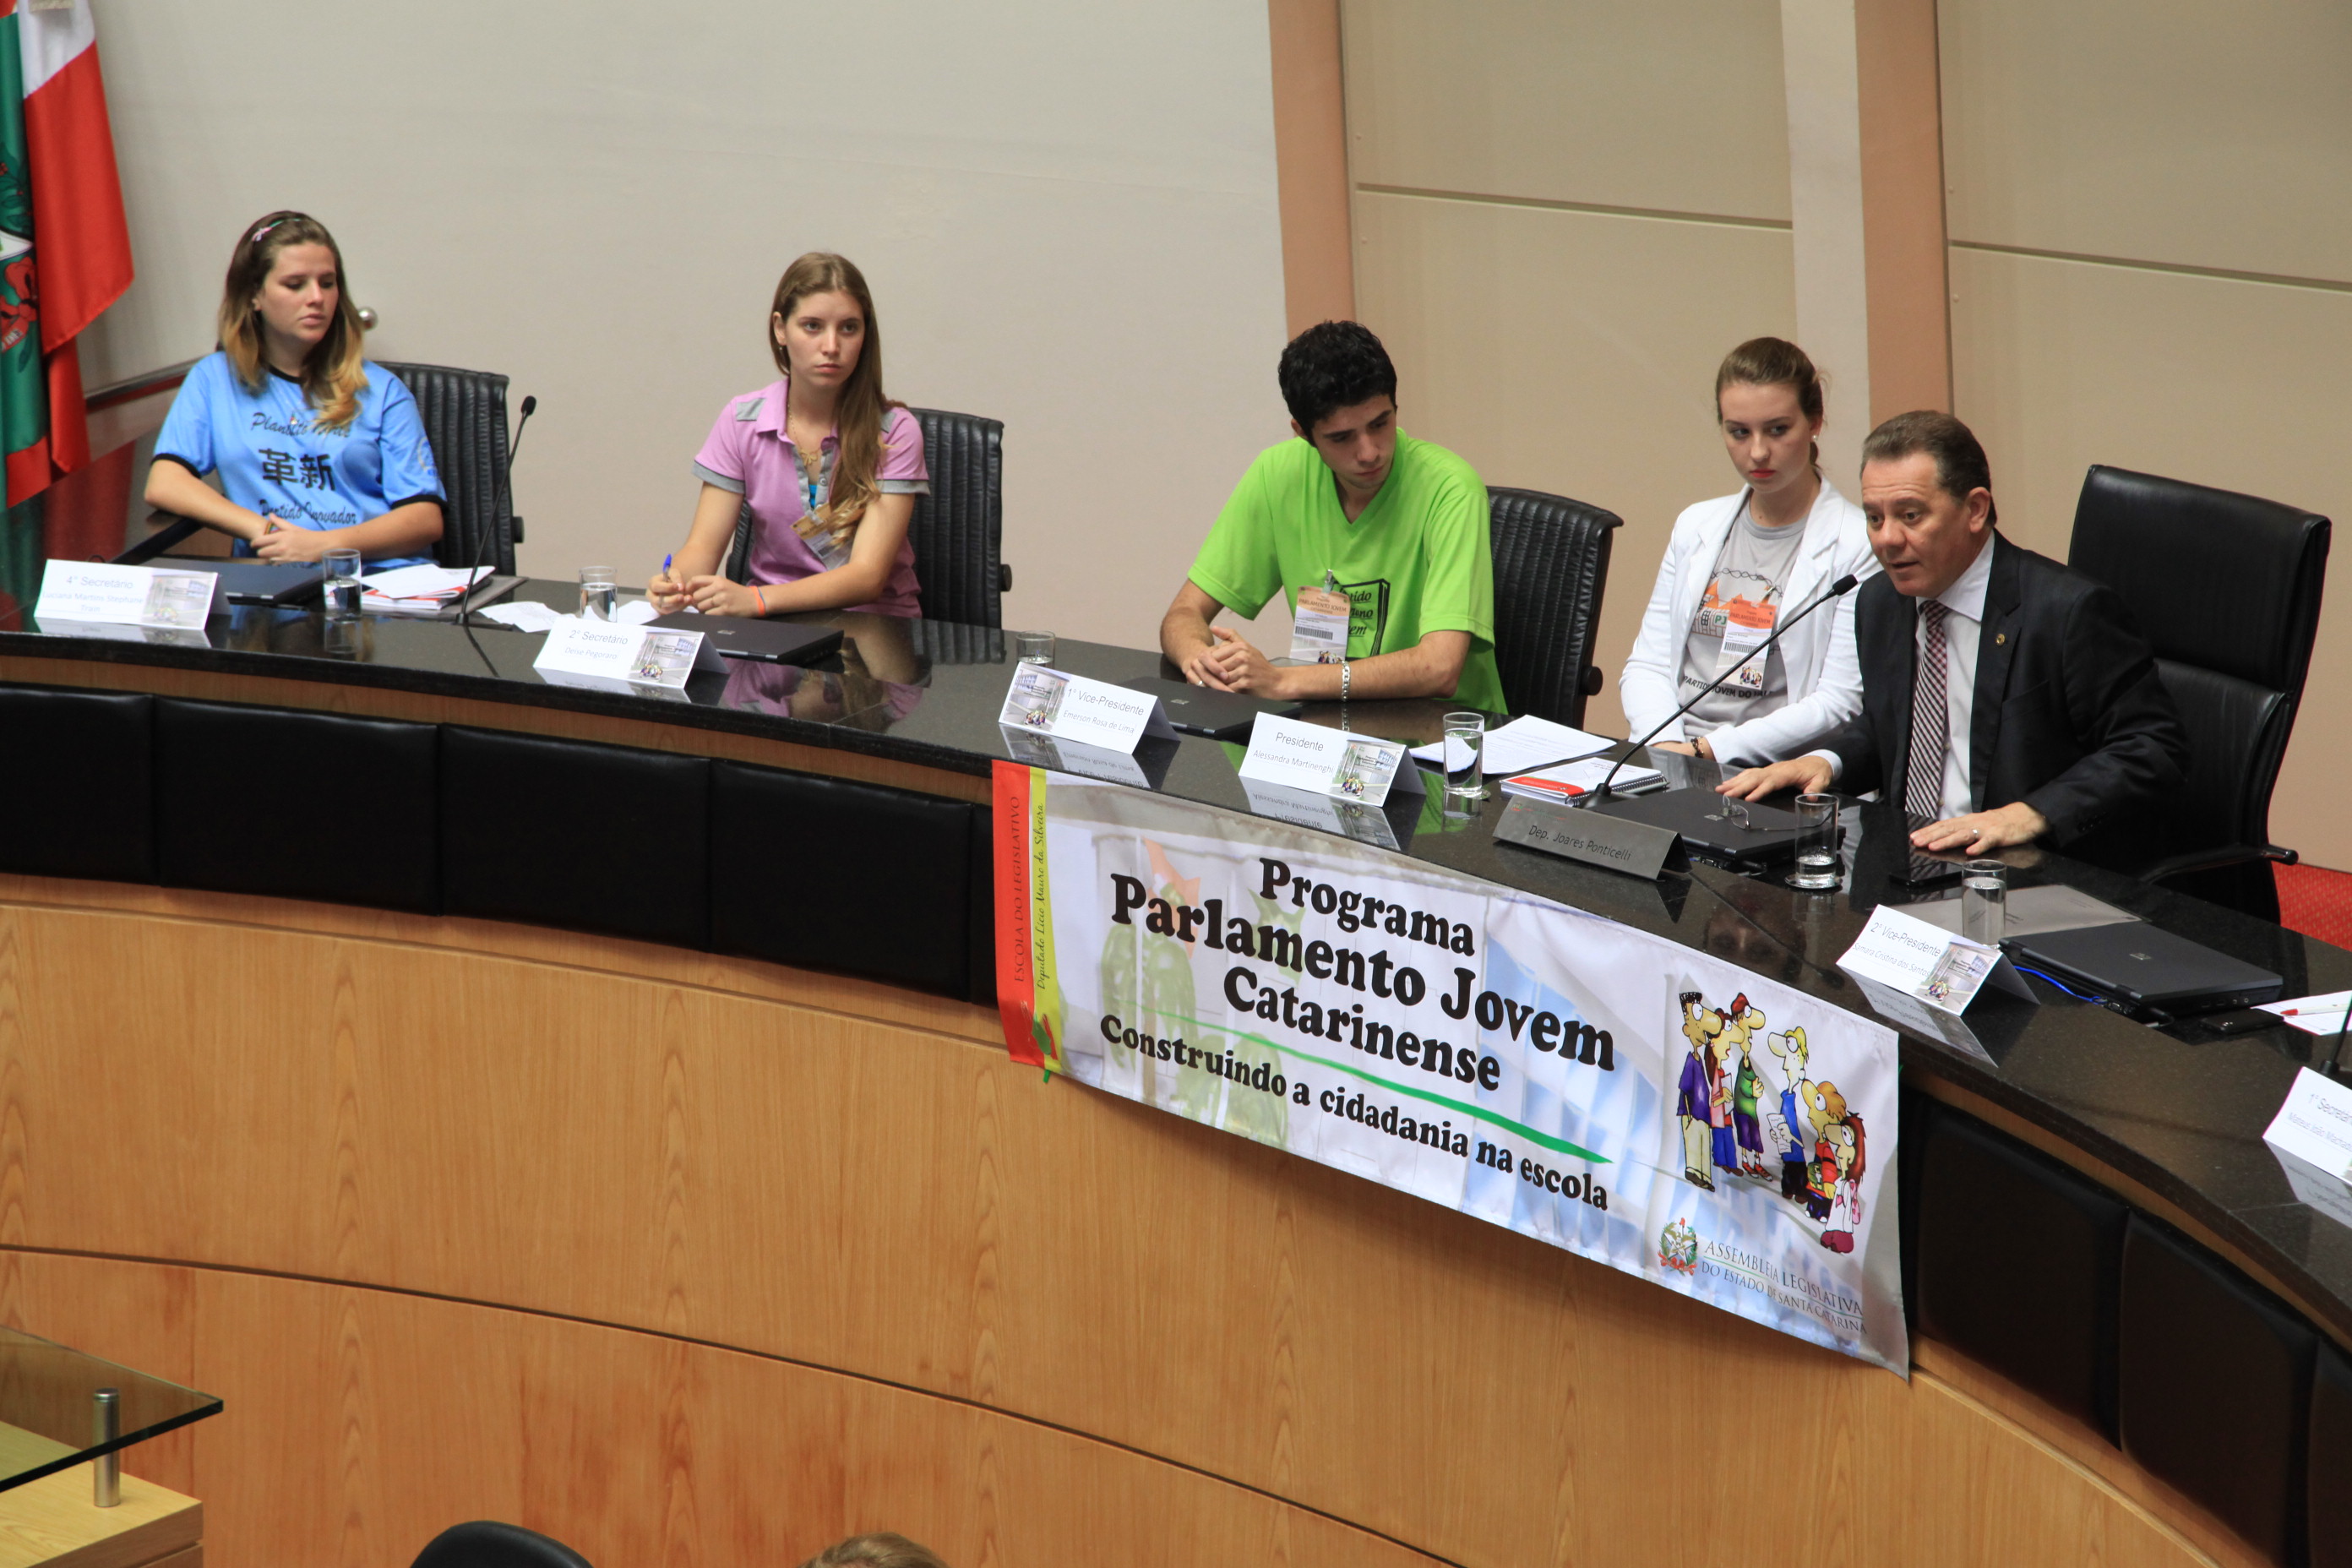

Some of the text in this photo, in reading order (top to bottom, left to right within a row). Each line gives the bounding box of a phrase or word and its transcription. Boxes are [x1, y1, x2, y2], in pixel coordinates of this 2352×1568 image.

[259, 448, 336, 492] 革新
[582, 631, 629, 645] Secretário
[1078, 690, 1145, 716] Vice-Presidente
[1685, 676, 1711, 690] PARTID
[1738, 689, 1752, 699] DO
[1064, 710, 1091, 723] Emerson
[1092, 716, 1108, 727] Rosa
[1108, 721, 1117, 729] de
[1276, 732, 1324, 752] Presidente
[1253, 749, 1334, 774] Alessandra Martinenghi
[1032, 803, 1044, 847] Silveira
[1529, 825, 1632, 861] Dep. Joares Ponticelli
[1033, 850, 1044, 864] da
[1010, 797, 1025, 983] ESCOLA DO LEGISLATIVO
[1035, 868, 1046, 906] Mauro
[1260, 858, 1475, 956] Programa
[1881, 926, 1941, 957] Vice-Presidente
[1035, 939, 1050, 989] Deputado
[1110, 873, 1615, 1072] Parlamento Jovem
[1875, 950, 1897, 965] Cristina
[1897, 959, 1909, 969] dos
[1908, 963, 1930, 977] Santos
[1223, 966, 1501, 1091] Catarinense
[1100, 1014, 1609, 1211] Construindo a cidadania na escola
[1705, 1240, 1865, 1315] ASSEMBLEIA LEGISLATIVA
[1701, 1261, 1721, 1277] DO
[1723, 1271, 1765, 1294] ESTADO
[1778, 1293, 1814, 1314] SANTA
[1814, 1305, 1867, 1335] CATARINA
